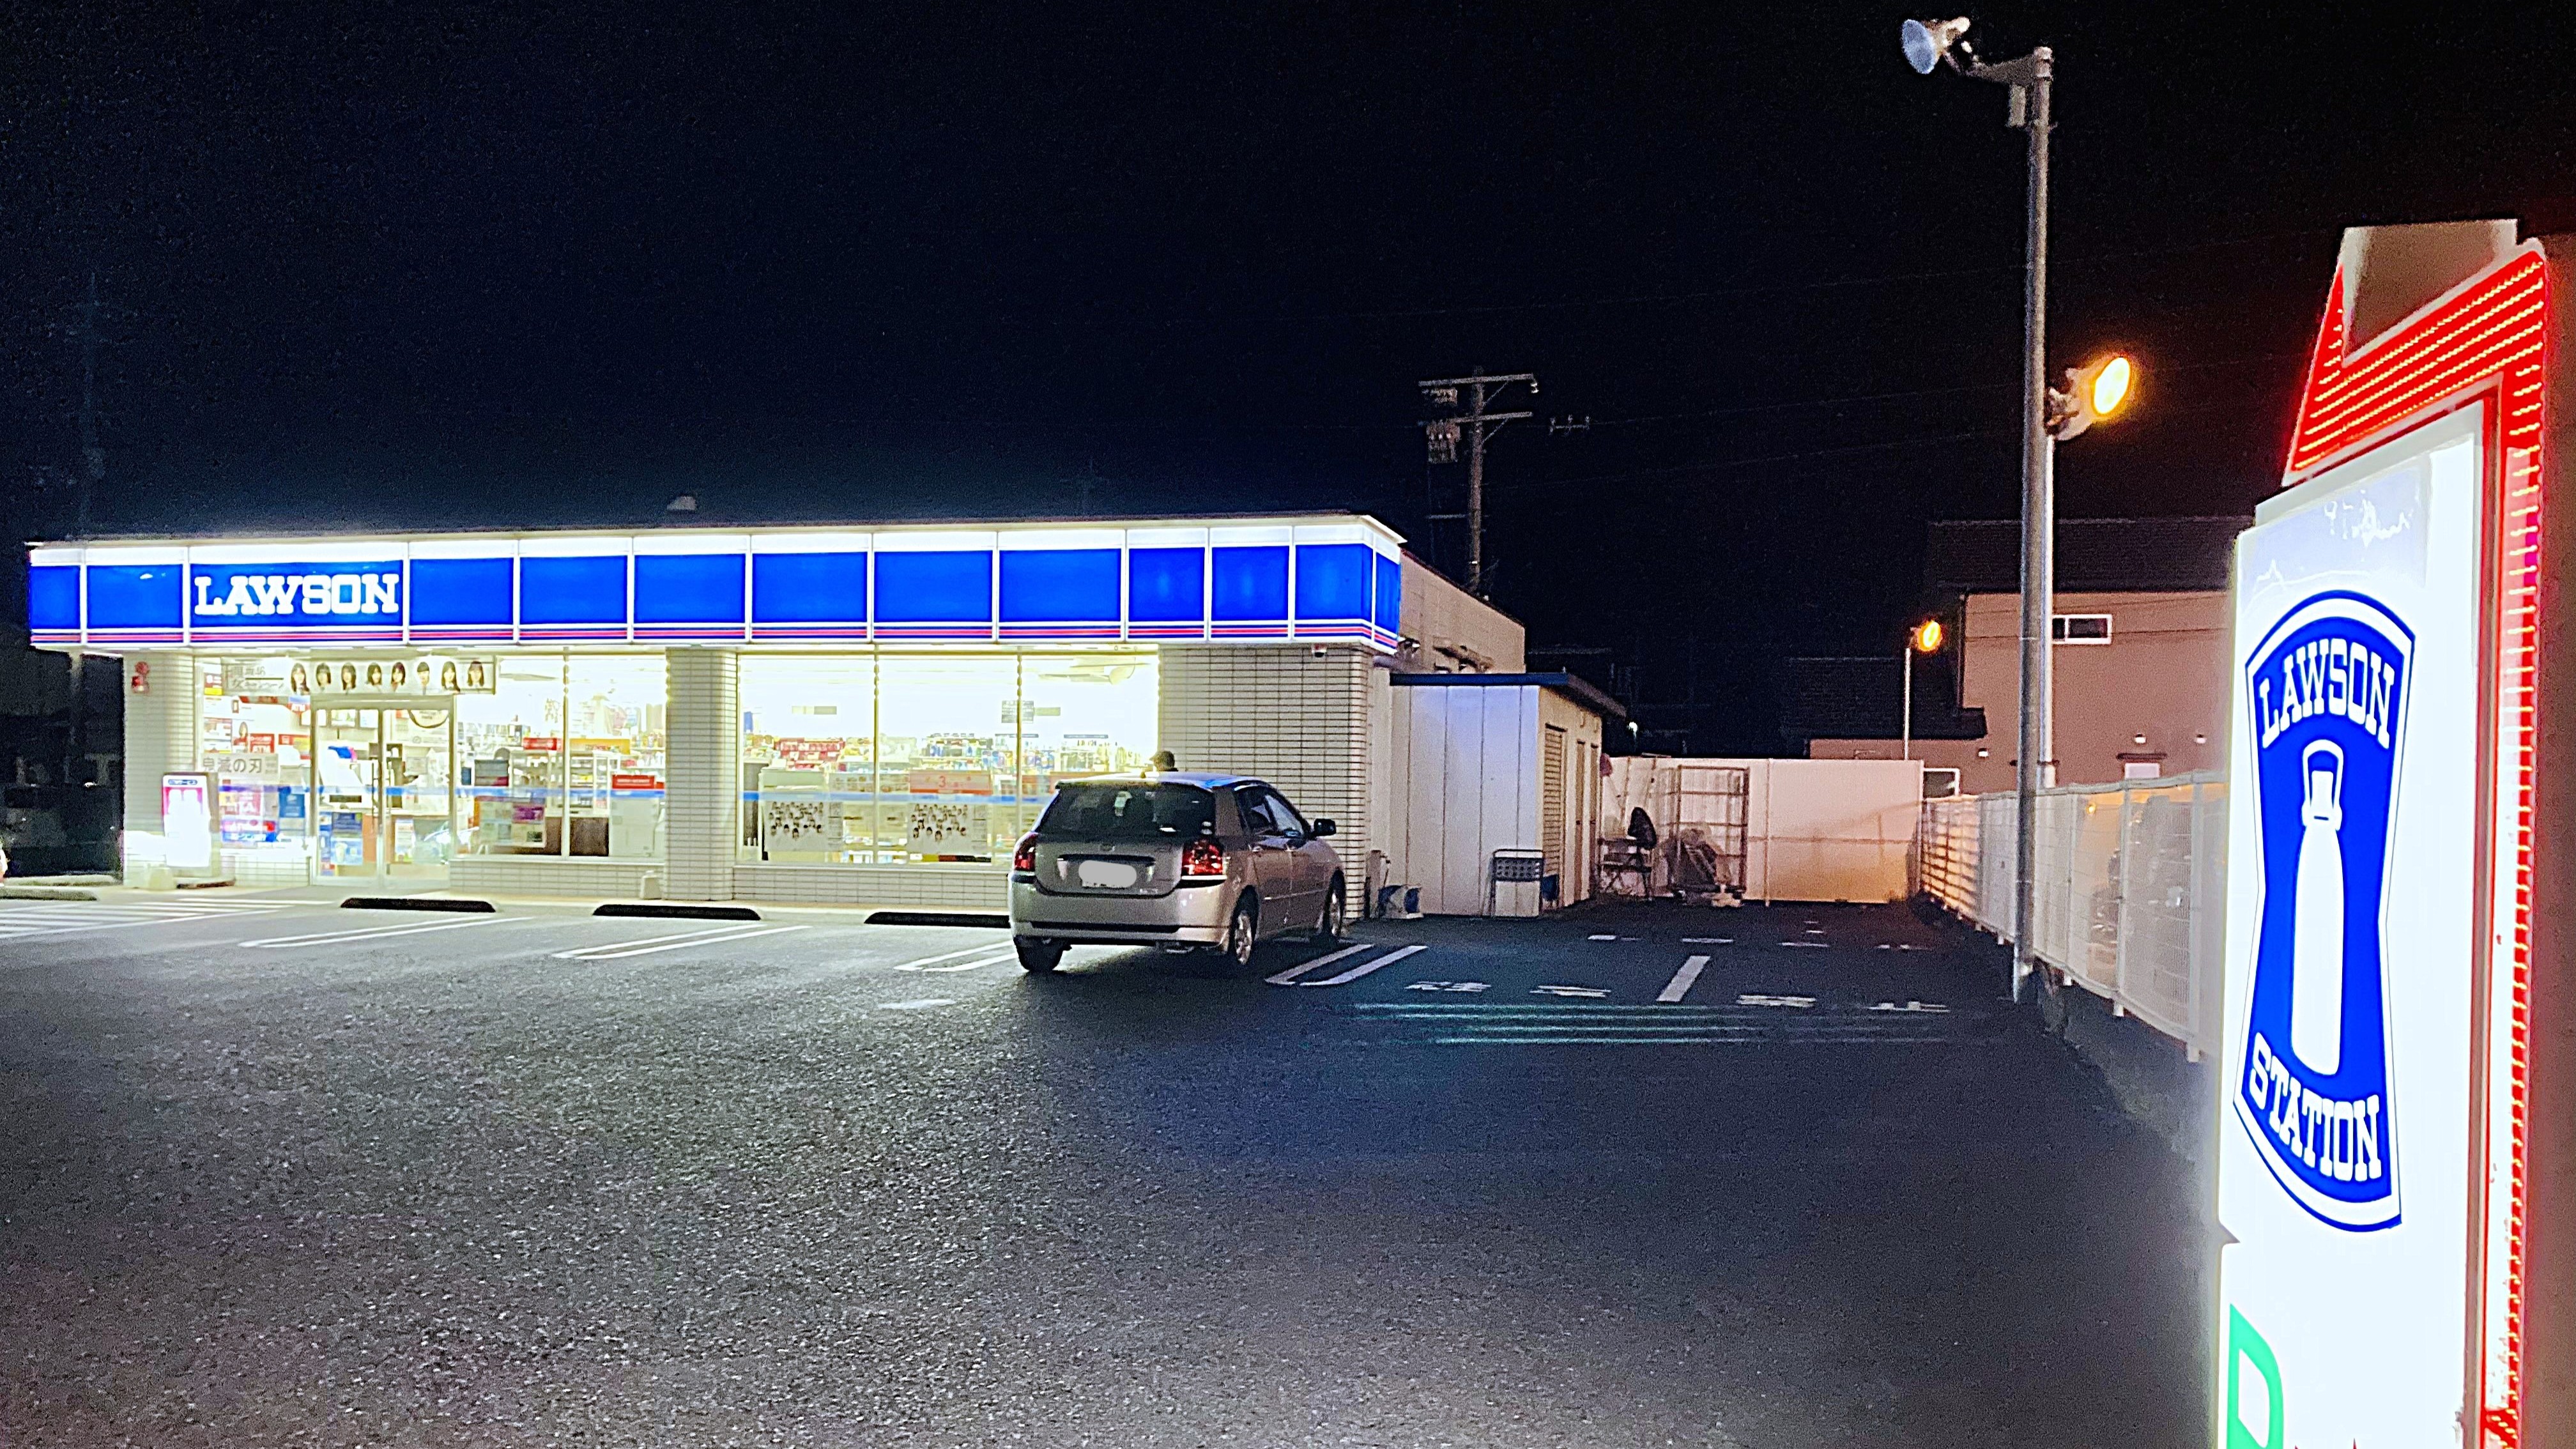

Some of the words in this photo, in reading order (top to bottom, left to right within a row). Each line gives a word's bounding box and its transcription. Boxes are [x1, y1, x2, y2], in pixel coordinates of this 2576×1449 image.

[194, 574, 399, 615] LAWSON
[2260, 638, 2395, 749] LAWSON
[2248, 1032, 2382, 1182] STATION
